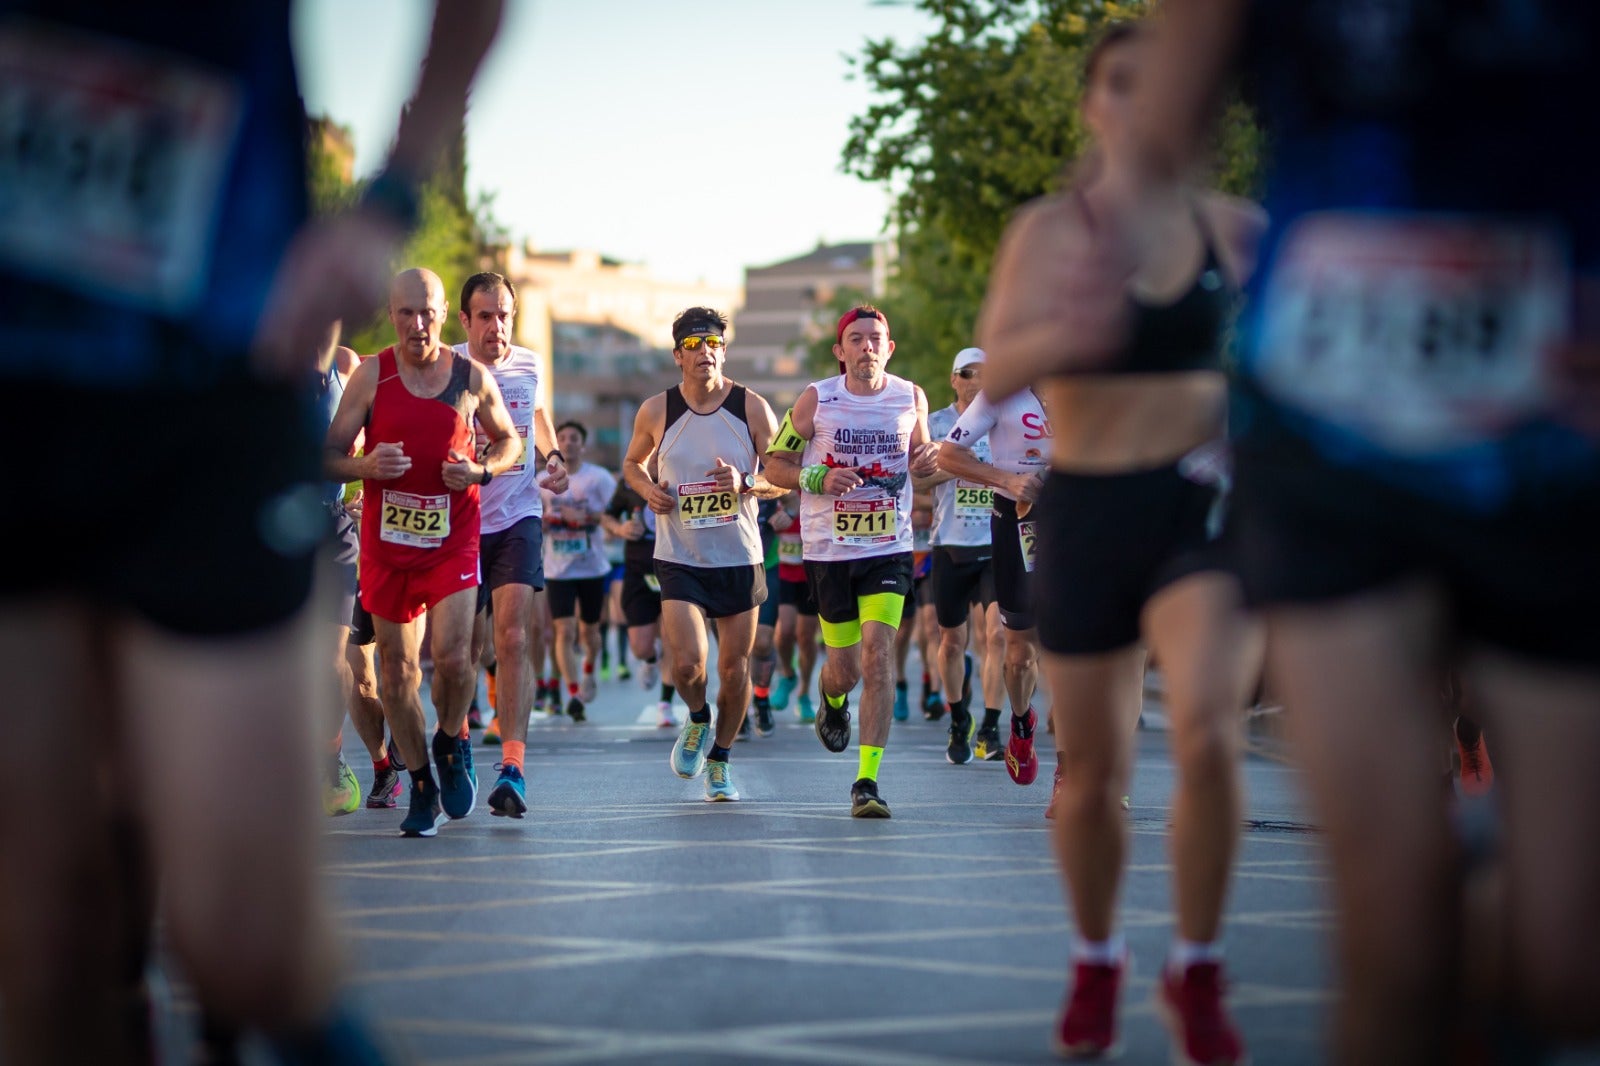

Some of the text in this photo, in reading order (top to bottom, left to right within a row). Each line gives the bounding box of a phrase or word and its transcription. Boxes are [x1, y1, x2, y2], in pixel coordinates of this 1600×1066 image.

[834, 428, 851, 444] 40
[851, 432, 907, 444] MEDIA MARAT
[834, 443, 862, 454] CIUDAD
[864, 444, 875, 454] DE
[680, 485, 690, 496] 40
[681, 492, 732, 514] 4726
[385, 505, 441, 531] 2752
[836, 512, 886, 532] 5711
